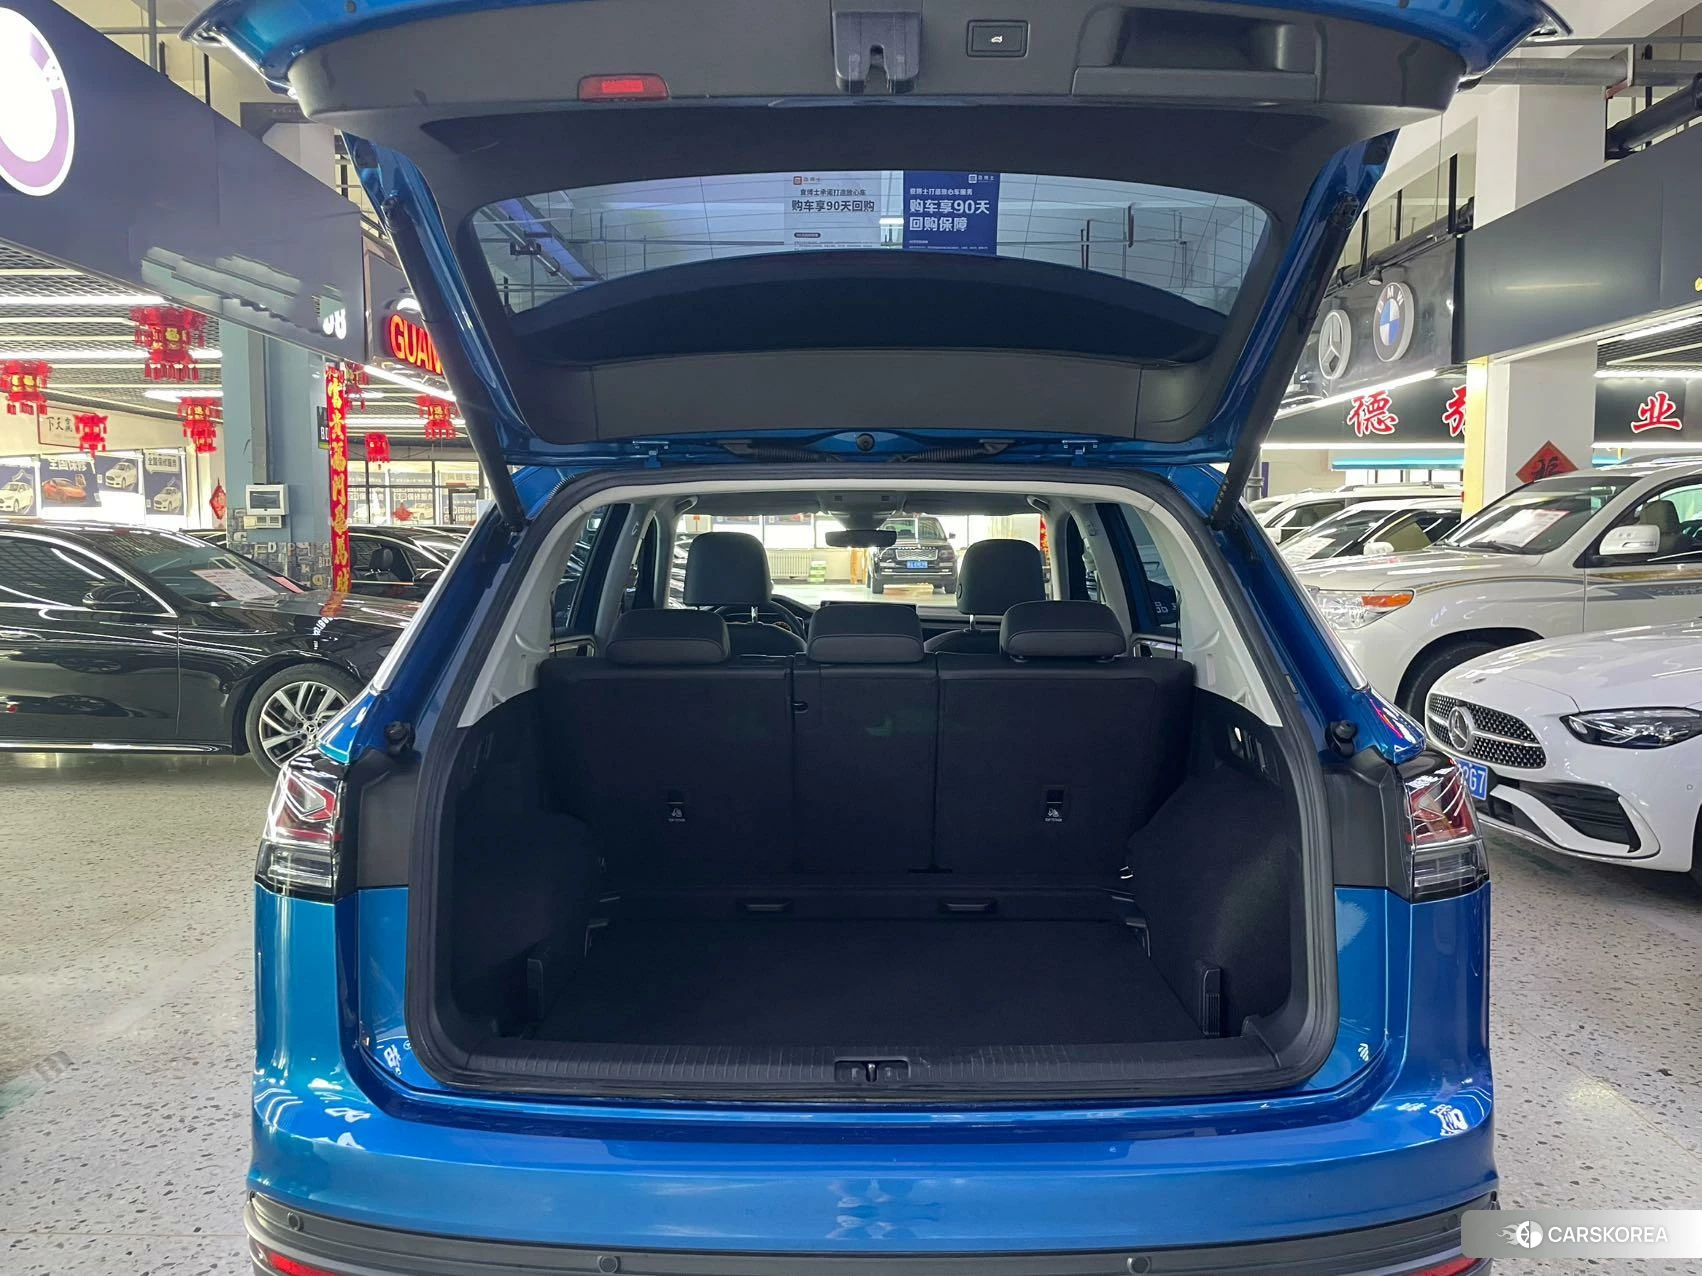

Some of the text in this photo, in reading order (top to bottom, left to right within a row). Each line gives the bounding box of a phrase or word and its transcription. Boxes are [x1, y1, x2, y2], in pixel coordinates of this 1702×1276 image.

[791, 200, 875, 212] 购车享90天回购
[909, 199, 990, 214] 购车享90天
[909, 217, 968, 232] 回购保障
[1346, 389, 1399, 437] 德
[1630, 391, 1683, 433] 业
